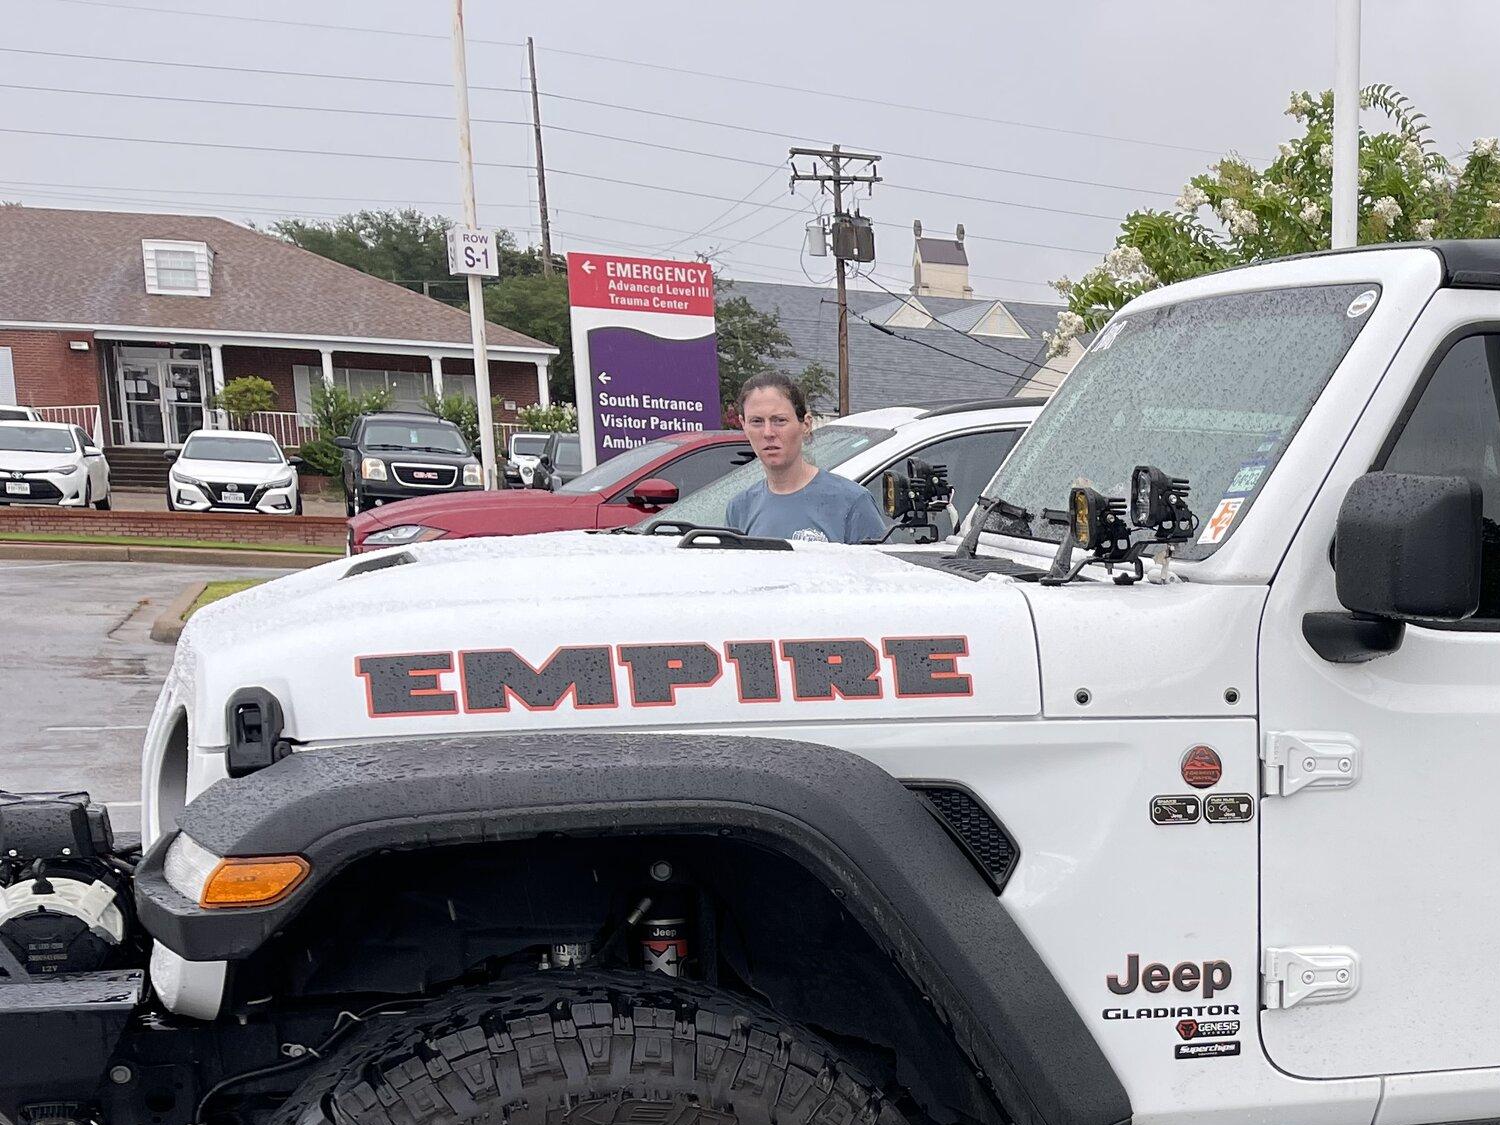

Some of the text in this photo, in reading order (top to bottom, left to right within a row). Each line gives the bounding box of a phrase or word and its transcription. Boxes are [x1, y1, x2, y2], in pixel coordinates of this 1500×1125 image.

[463, 234, 488, 244] ROW
[464, 246, 489, 269] S-1
[606, 262, 708, 284] EMERGENCY
[608, 280, 664, 295] Advanced
[666, 283, 696, 297] Level
[608, 294, 689, 310] Trauma Center
[599, 392, 703, 412] South Entrance
[600, 413, 647, 429] Visitor
[413, 471, 438, 480] GMC
[354, 635, 974, 718] EMPIRE
[653, 928, 677, 937] Jeep
[1106, 953, 1233, 999] Jeep
[1102, 1004, 1240, 1020] GLADIATOR
[1197, 1021, 1239, 1032] GENESIS
[1179, 1043, 1236, 1054] Superchips
